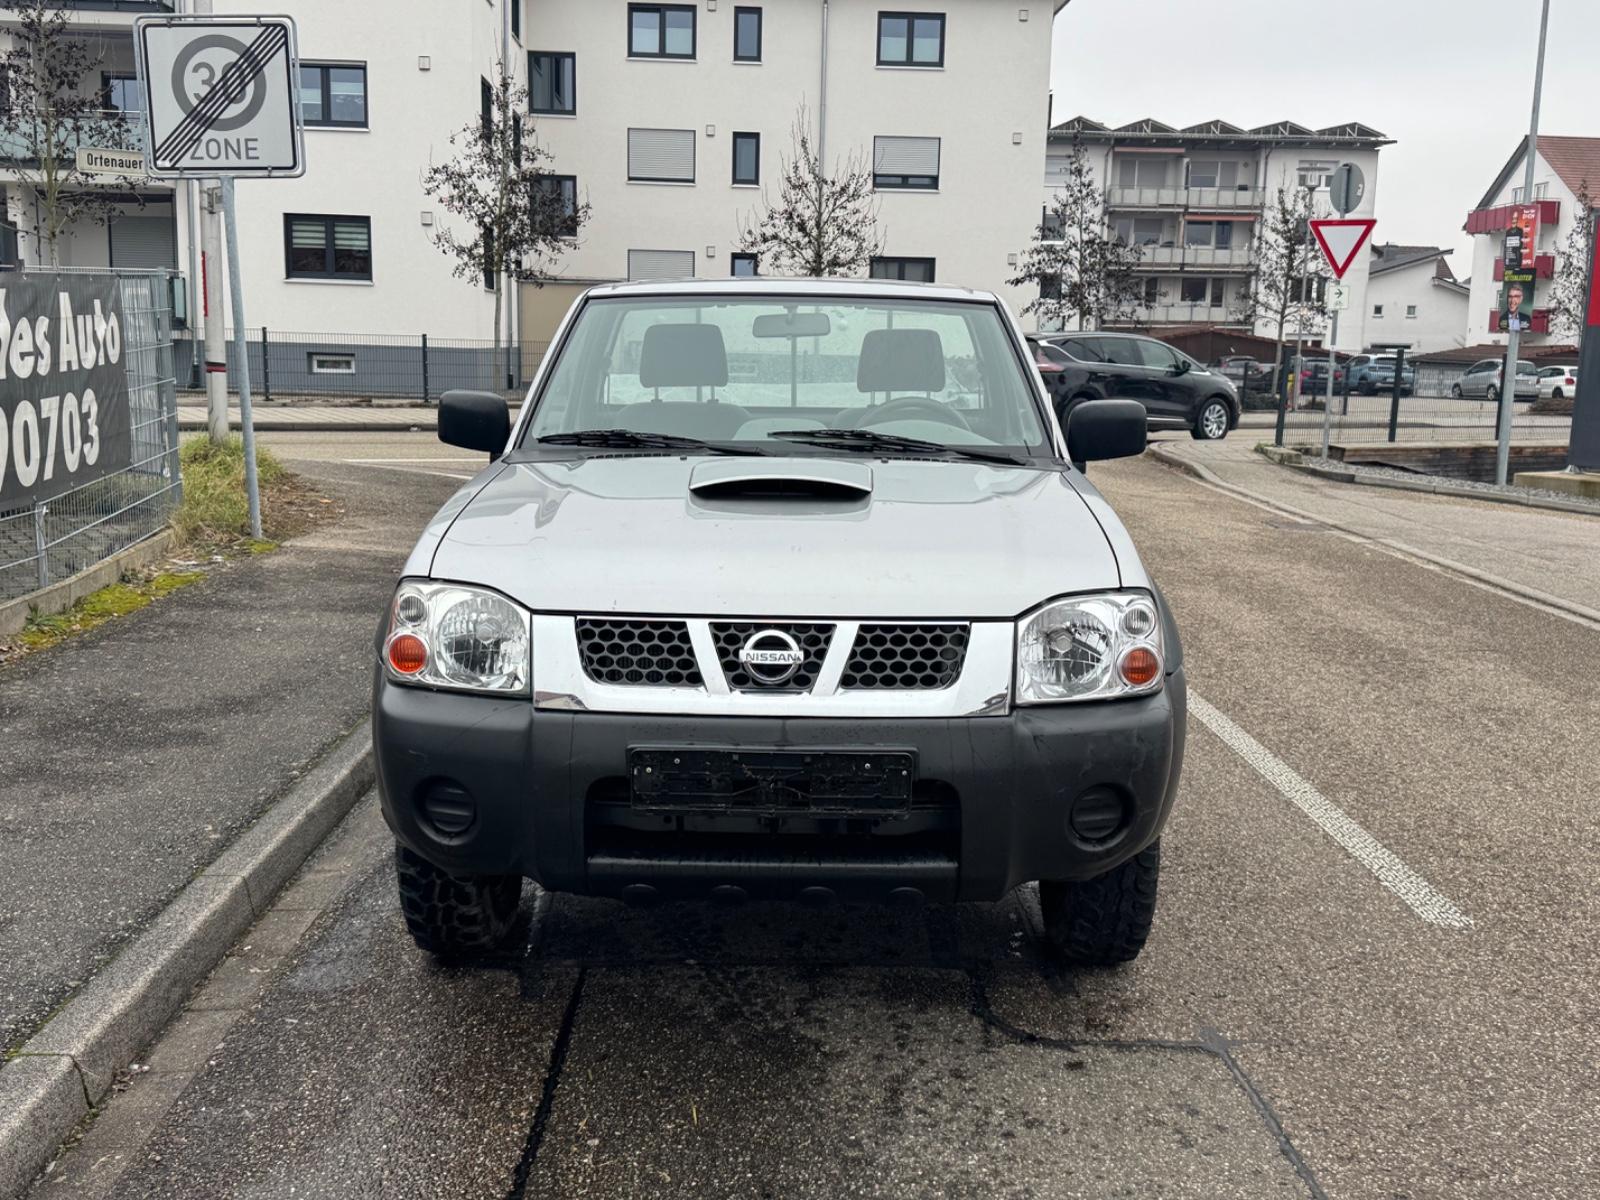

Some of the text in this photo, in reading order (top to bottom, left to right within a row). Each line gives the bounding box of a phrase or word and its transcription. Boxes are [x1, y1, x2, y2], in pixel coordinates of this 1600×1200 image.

[190, 137, 260, 160] ZONE
[86, 152, 143, 169] Ortenauer
[59, 291, 121, 373] Auto
[745, 652, 799, 662] NISSAN
